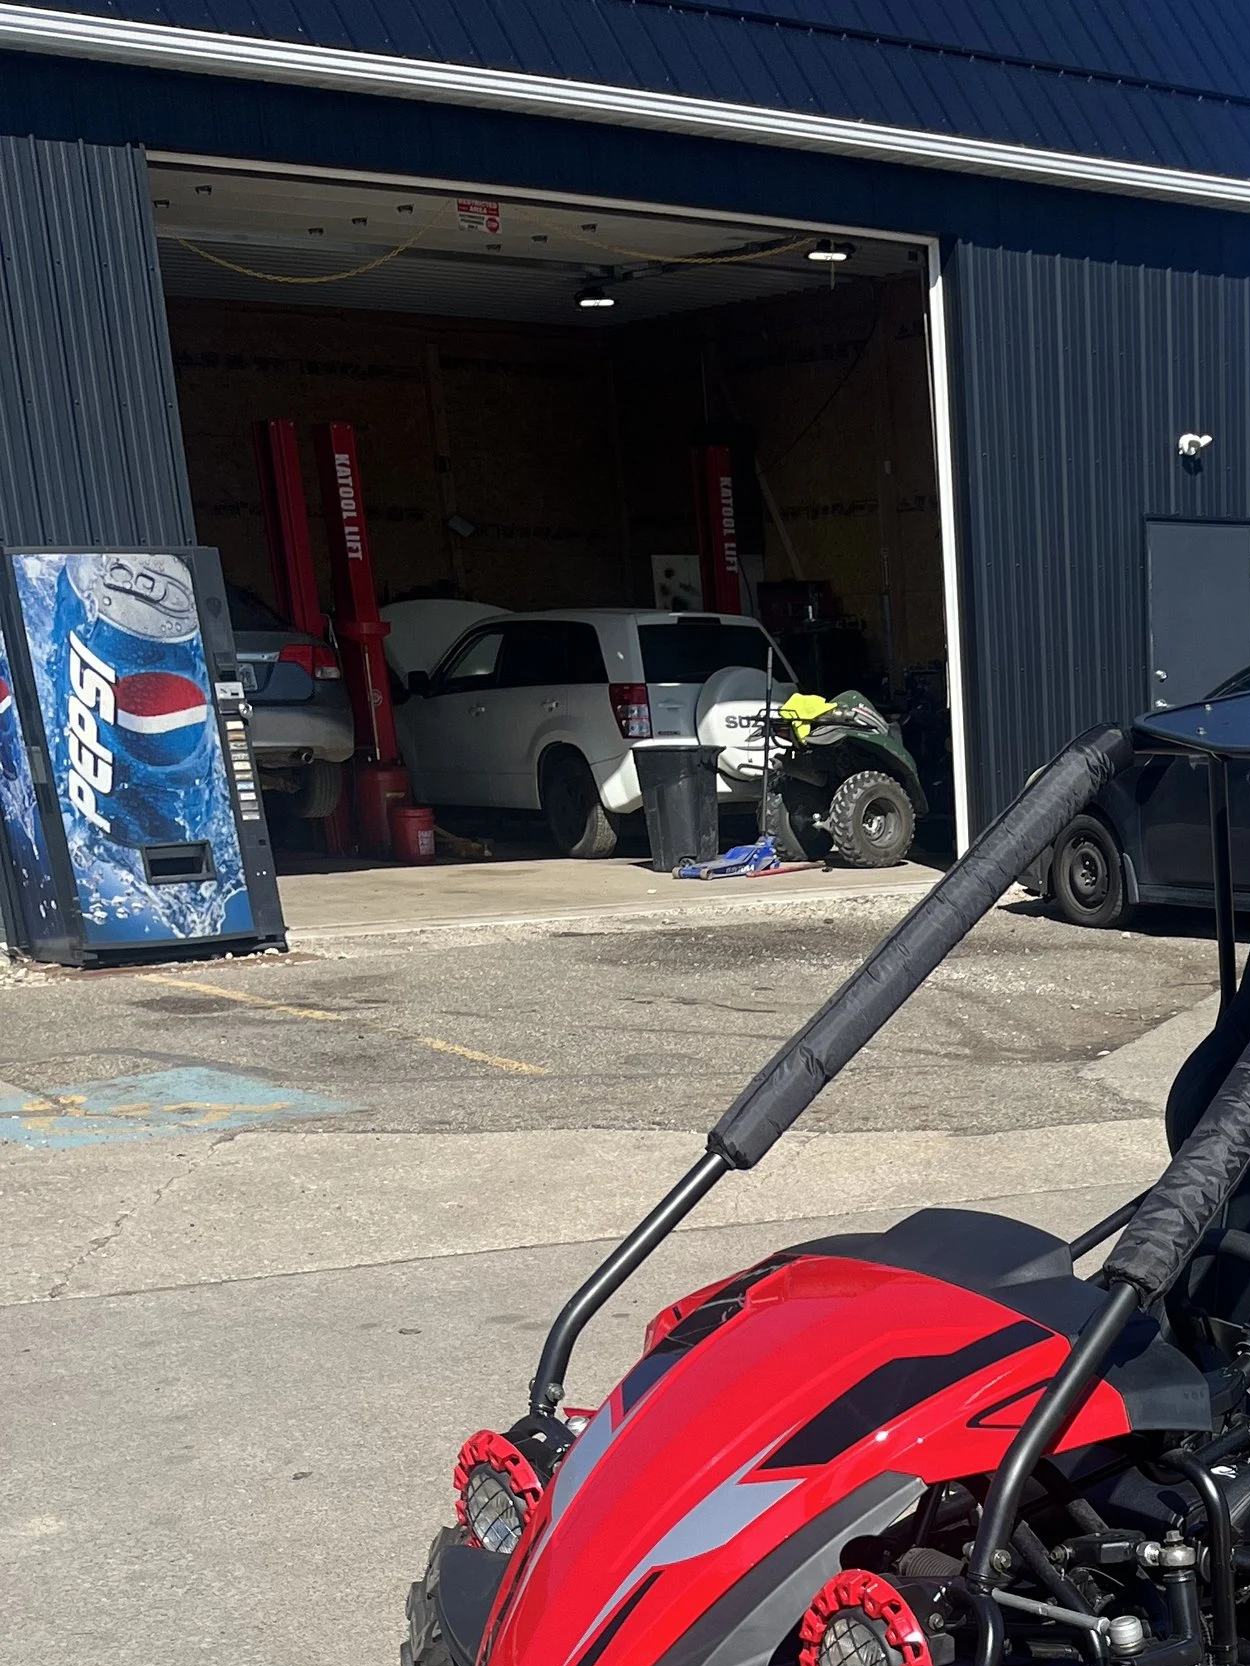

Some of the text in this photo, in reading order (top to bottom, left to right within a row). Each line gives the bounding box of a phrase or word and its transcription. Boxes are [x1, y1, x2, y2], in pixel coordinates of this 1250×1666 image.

[334, 453, 363, 561] KATOOL LIFT
[720, 477, 739, 574] KATOOL LIFT
[67, 631, 118, 834] PEPSI
